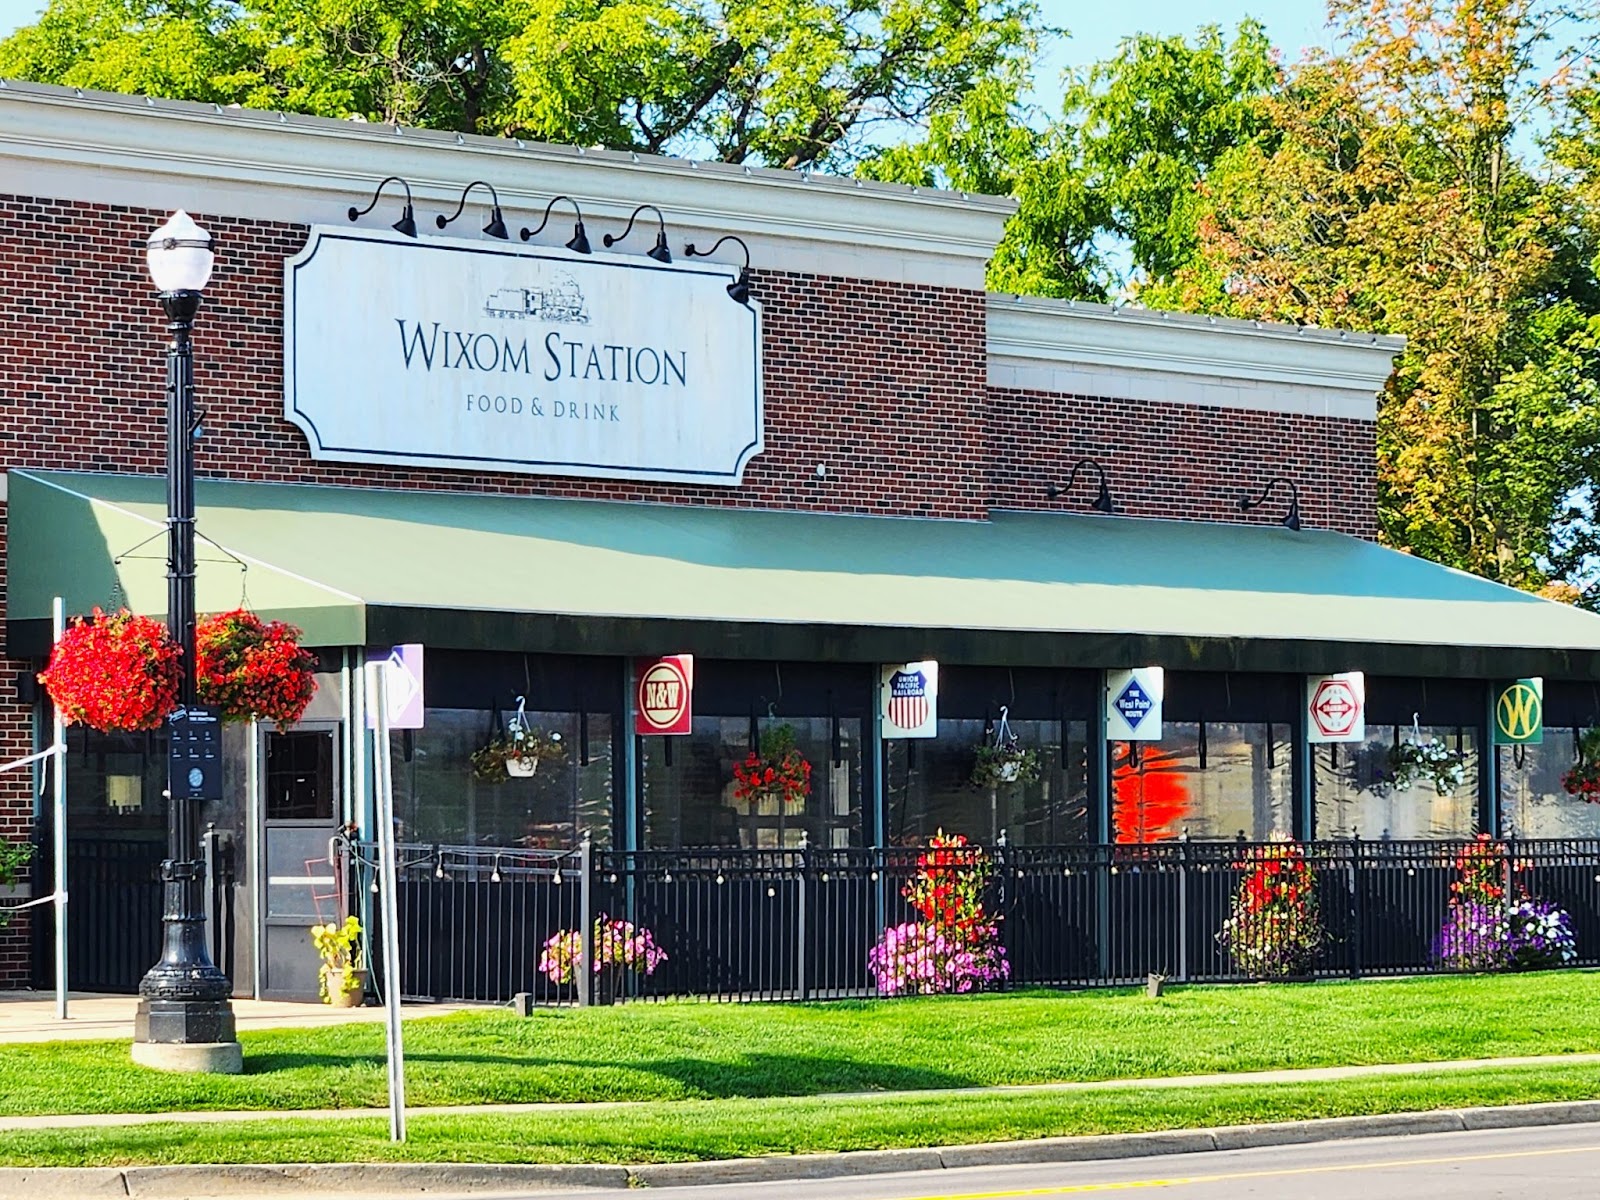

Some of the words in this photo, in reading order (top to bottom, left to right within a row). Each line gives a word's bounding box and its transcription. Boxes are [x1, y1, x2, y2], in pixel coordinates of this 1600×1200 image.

[467, 394, 523, 415] FOOD
[531, 396, 545, 417] &
[553, 400, 620, 422] DRINK
[646, 682, 680, 709] N&W
[893, 688, 924, 696] RAILROAD
[1501, 685, 1535, 737] W
